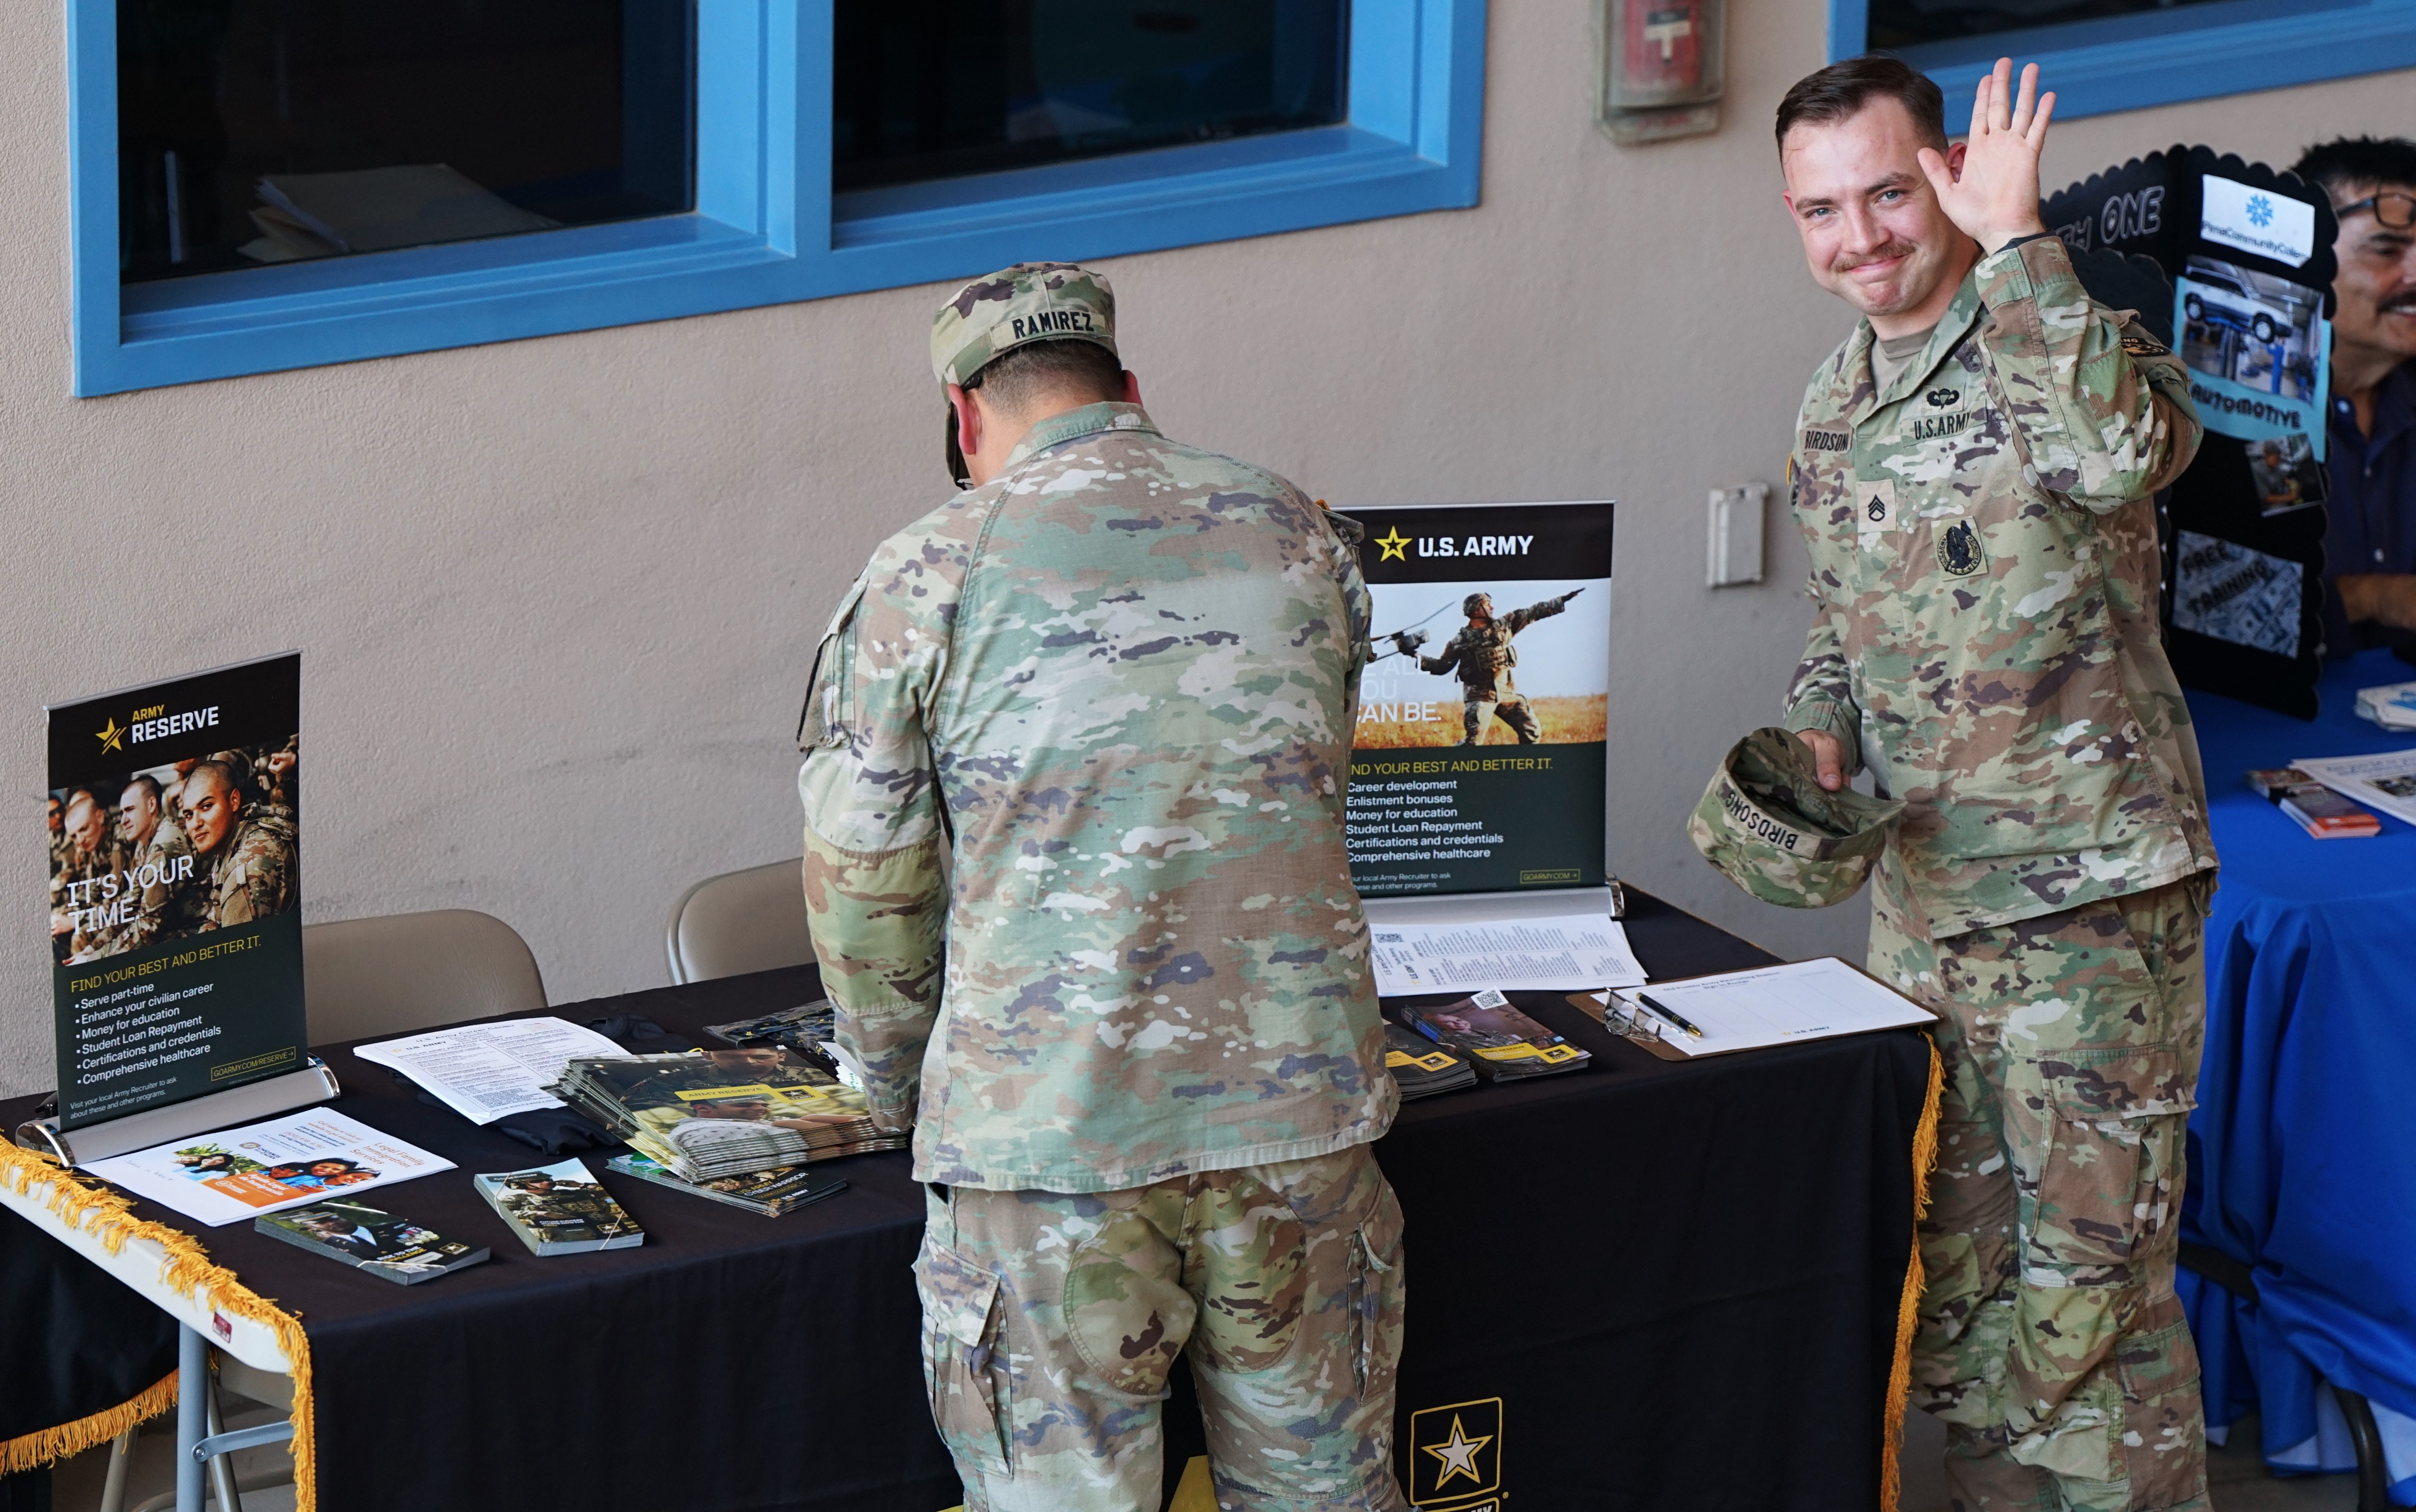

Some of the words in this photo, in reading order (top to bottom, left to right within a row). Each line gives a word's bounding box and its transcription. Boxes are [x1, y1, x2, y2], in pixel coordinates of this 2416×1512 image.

[2101, 185, 2165, 244] ONE
[1012, 311, 1094, 339] RAMIREZ
[2190, 383, 2301, 429] AUTOMOTIVE
[1804, 431, 1849, 451] BIRDSON
[1418, 537, 1459, 557] U.S.
[1463, 535, 1533, 556] ARMY
[1384, 654, 1430, 676] ALL
[1361, 679, 1397, 700] OU
[132, 704, 164, 722] ARMY
[1404, 701, 1442, 721] BE.
[132, 706, 219, 743] RESERVE
[1351, 764, 1370, 775] ND
[1374, 762, 1410, 774] YOUR
[1414, 761, 1448, 773] BEST
[1451, 760, 1480, 772] AND
[1483, 758, 1534, 771] BETTER
[1537, 757, 1553, 770] IT.
[1348, 782, 1384, 793] Career
[1386, 779, 1457, 795] development
[1346, 795, 1404, 807] Enlistment
[1406, 794, 1453, 805] bonuses
[1346, 810, 1383, 823] Money
[1385, 809, 1401, 819] for
[1403, 807, 1458, 818] education
[1725, 790, 1799, 850] BIRDSONG
[1346, 824, 1390, 835] Student
[1392, 823, 1419, 833] Loan
[1421, 820, 1483, 834] Repayment
[1346, 836, 1418, 849] Certifications
[1421, 835, 1441, 845] and
[1443, 832, 1504, 845] credentials
[1348, 849, 1431, 863] Comprehensive
[1433, 848, 1491, 860] healthcare
[67, 874, 117, 907] IT'S
[123, 855, 194, 889] YOUR
[1404, 882, 1438, 890] programs.
[68, 897, 140, 935] TIME.
[71, 976, 101, 993] FIND
[104, 969, 136, 985] YOUR
[138, 958, 168, 976] BEST
[172, 951, 197, 968] AND
[199, 941, 244, 961] BETTER
[247, 936, 261, 950] IT.
[81, 994, 109, 1009] Serve
[111, 983, 154, 1004] part-time
[82, 1007, 122, 1024] Enhance
[125, 1001, 145, 1016] your
[148, 991, 180, 1008] civilian
[183, 983, 214, 999] career
[82, 1024, 114, 1040] Money
[116, 1019, 129, 1031] for
[131, 1006, 180, 1028] education
[82, 1038, 120, 1054] Student
[122, 1031, 146, 1046] Loan
[148, 1016, 202, 1039] Repayment
[82, 1046, 146, 1069] Certifications
[149, 1041, 166, 1054] and
[168, 1025, 221, 1047] credentials
[83, 1060, 158, 1085] Comprehensive
[160, 1044, 211, 1064] healthcare
[84, 1098, 97, 1107] your
[99, 1093, 112, 1103] local
[114, 1089, 130, 1099] Army
[131, 1082, 157, 1094] Recruiter
[166, 1077, 177, 1085] ask
[70, 1110, 87, 1119] about
[88, 1106, 105, 1115] these
[120, 1099, 135, 1107] other
[136, 1091, 166, 1107] programs.
[349, 1148, 384, 1165] Services
[362, 1145, 411, 1168] Immigration
[374, 1142, 397, 1155] Legal
[398, 1151, 426, 1166] Family
[744, 1186, 773, 1196] CYBER
[769, 1172, 809, 1188] WARRIOR
[750, 1181, 773, 1190] ARMY
[791, 1189, 810, 1198] ARMY
